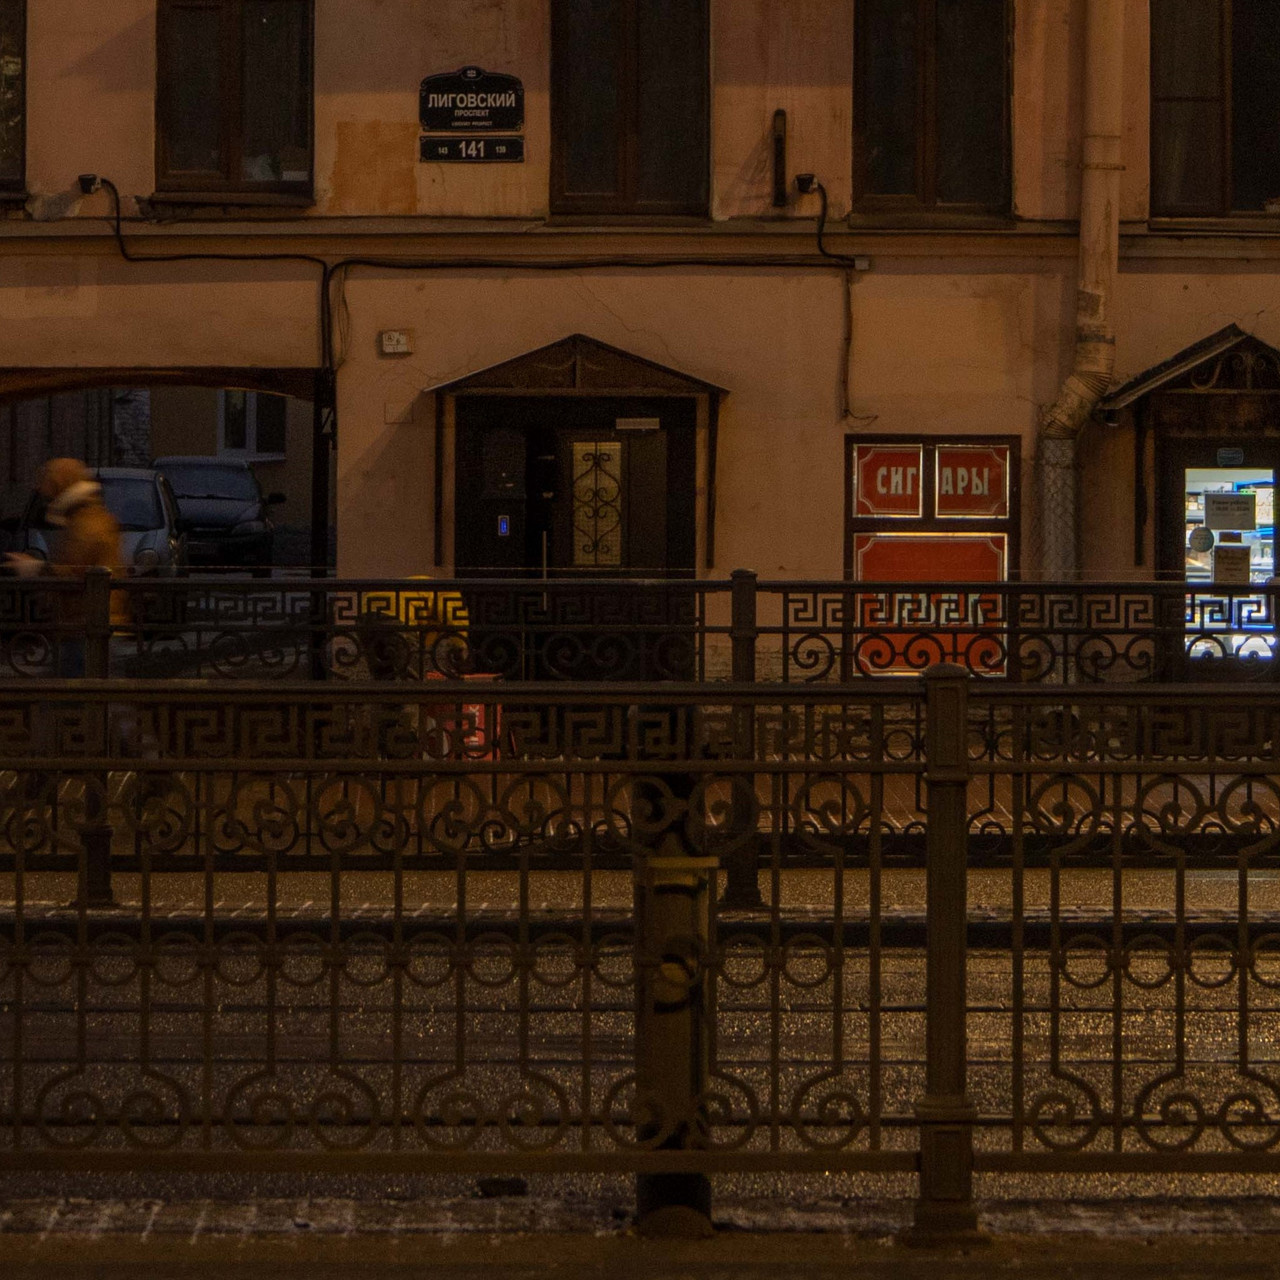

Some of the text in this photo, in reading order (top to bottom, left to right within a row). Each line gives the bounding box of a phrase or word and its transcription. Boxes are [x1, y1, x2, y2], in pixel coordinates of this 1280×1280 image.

[428, 91, 516, 108] ЛИГОВСКИЙ
[454, 109, 490, 117] ПРОСПЕКТ
[459, 140, 485, 158] 141
